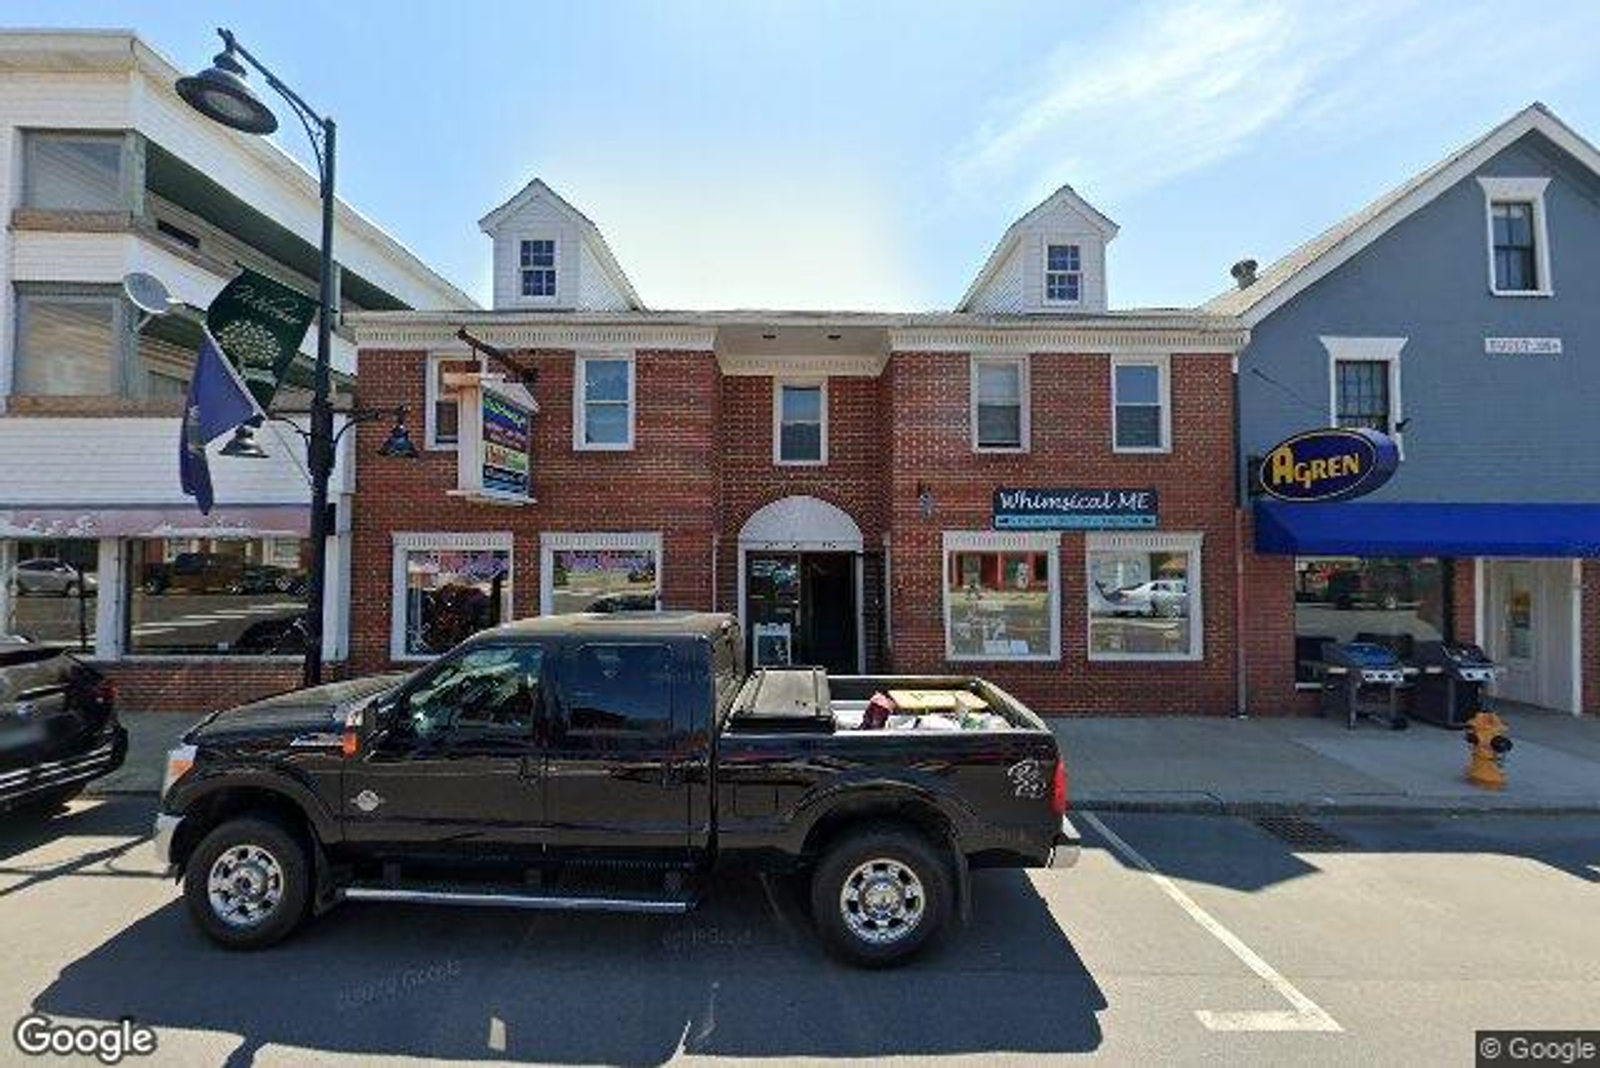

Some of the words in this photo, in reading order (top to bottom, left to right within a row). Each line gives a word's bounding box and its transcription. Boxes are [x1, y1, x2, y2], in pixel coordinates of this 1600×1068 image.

[1272, 444, 1360, 489] AGREN
[999, 490, 1117, 511] Whimsical
[1118, 491, 1150, 511] ME
